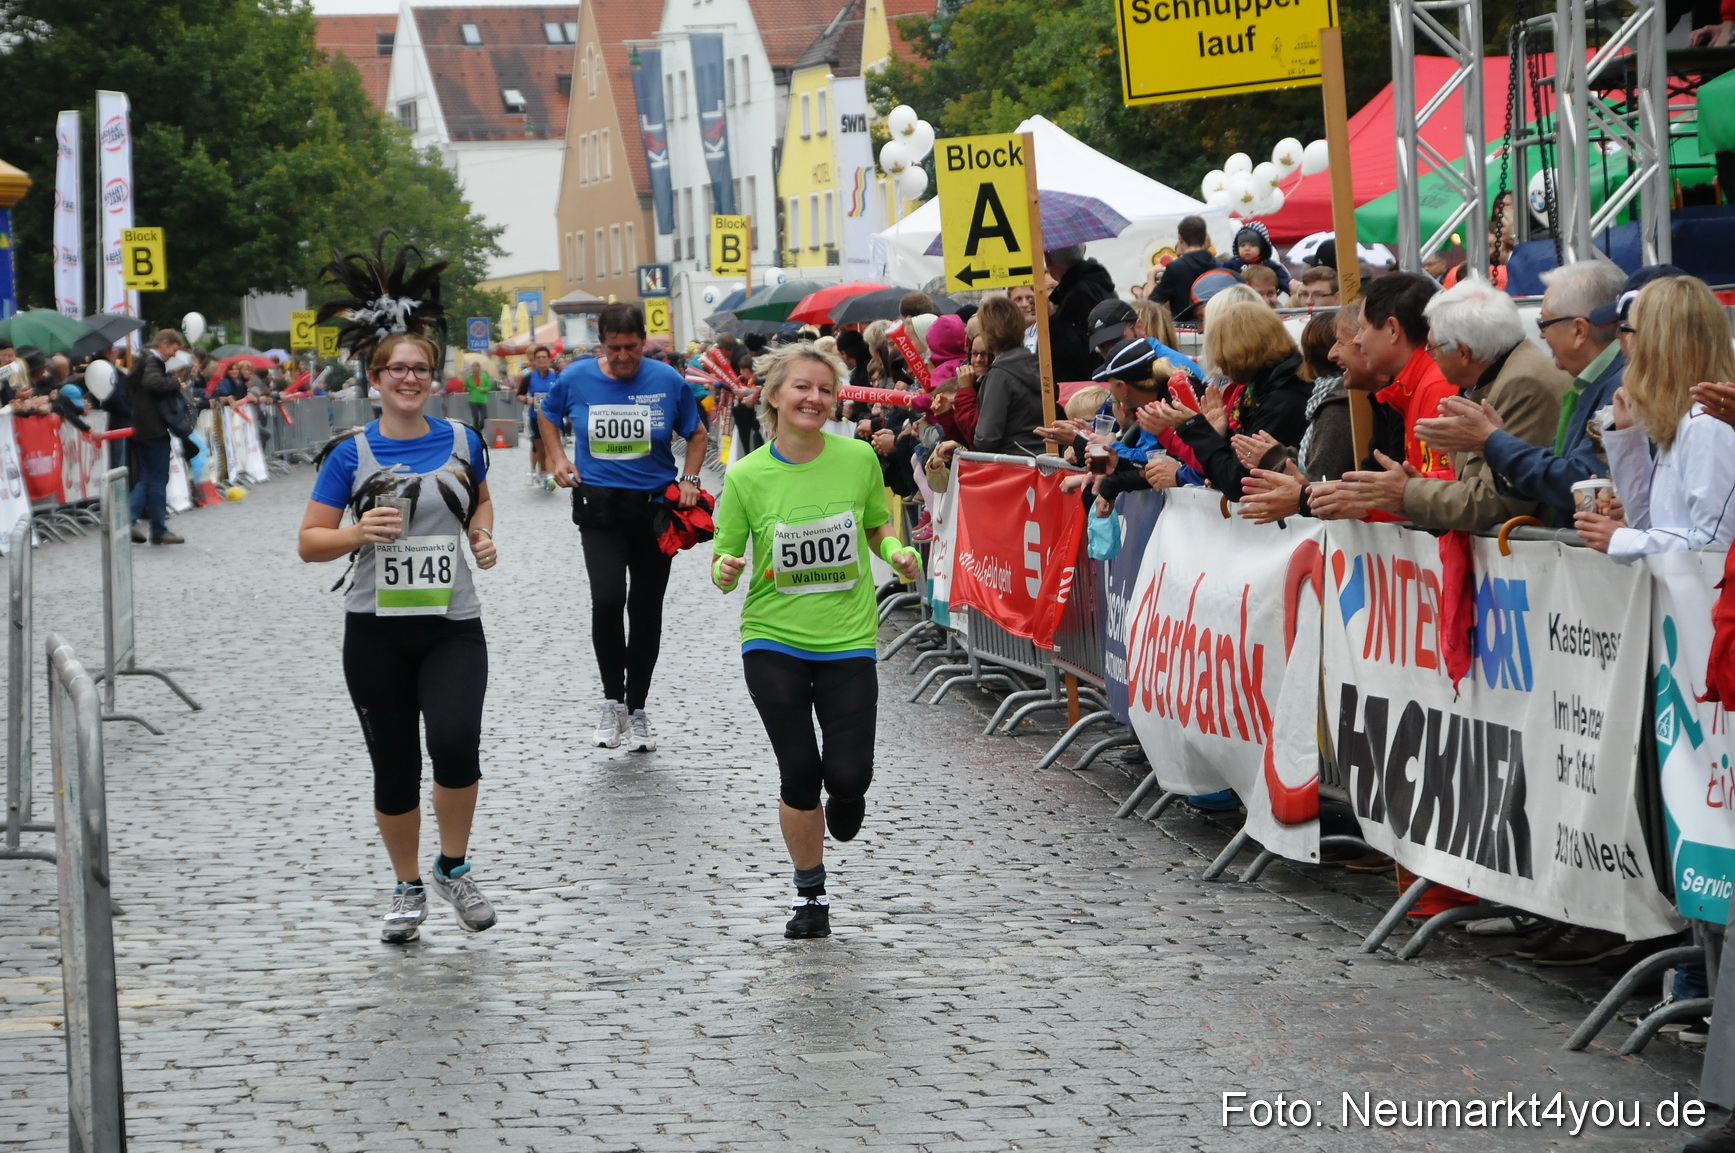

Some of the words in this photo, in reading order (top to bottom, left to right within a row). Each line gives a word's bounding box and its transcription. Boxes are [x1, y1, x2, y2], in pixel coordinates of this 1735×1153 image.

[1198, 25, 1257, 57] lauf
[946, 140, 1024, 172] Block
[812, 162, 831, 184] HOTEL
[716, 217, 747, 229] Block
[964, 182, 1021, 256] A
[124, 230, 157, 242] Block
[722, 234, 741, 263] B
[132, 247, 153, 276] B
[652, 309, 664, 327] C
[296, 321, 309, 339] C
[470, 339, 488, 347] TAXI
[896, 335, 918, 361] Audi
[913, 361, 930, 385] BKK
[838, 388, 866, 400] Audi
[869, 391, 893, 403] BKK
[595, 418, 645, 439] 5009
[606, 444, 633, 454] Jürgen
[775, 530, 801, 540] PARTL
[803, 523, 842, 537] Neumarkt
[376, 545, 403, 553] PARTL
[405, 544, 445, 552] Neumarkt
[781, 533, 852, 568] 5002
[384, 555, 452, 586] 5148
[792, 571, 846, 584] Walburga
[1128, 562, 1274, 746] Oberbank
